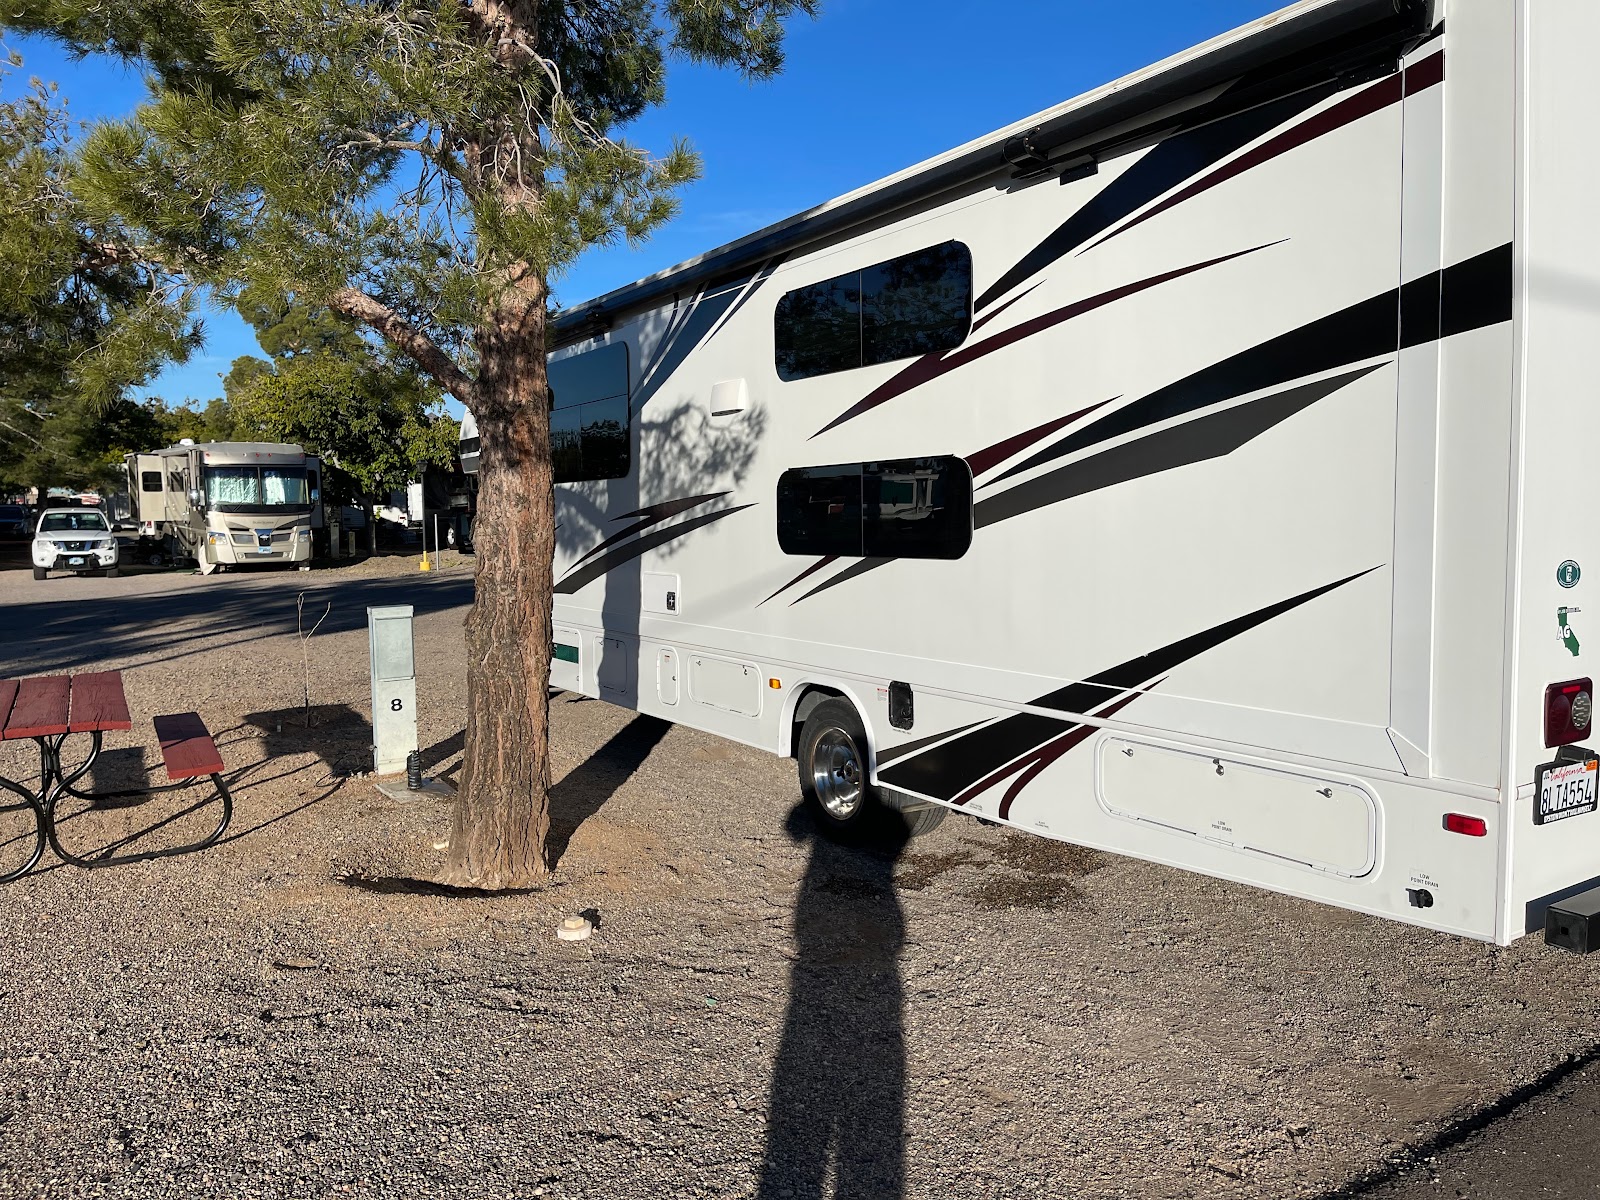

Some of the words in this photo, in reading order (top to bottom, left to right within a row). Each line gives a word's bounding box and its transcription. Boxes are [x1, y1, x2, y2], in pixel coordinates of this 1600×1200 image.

[1556, 624, 1571, 640] AG
[391, 698, 403, 711] 8
[1550, 766, 1586, 782] California
[1541, 778, 1592, 814] 8LTA554
[1410, 876, 1424, 884] POINT
